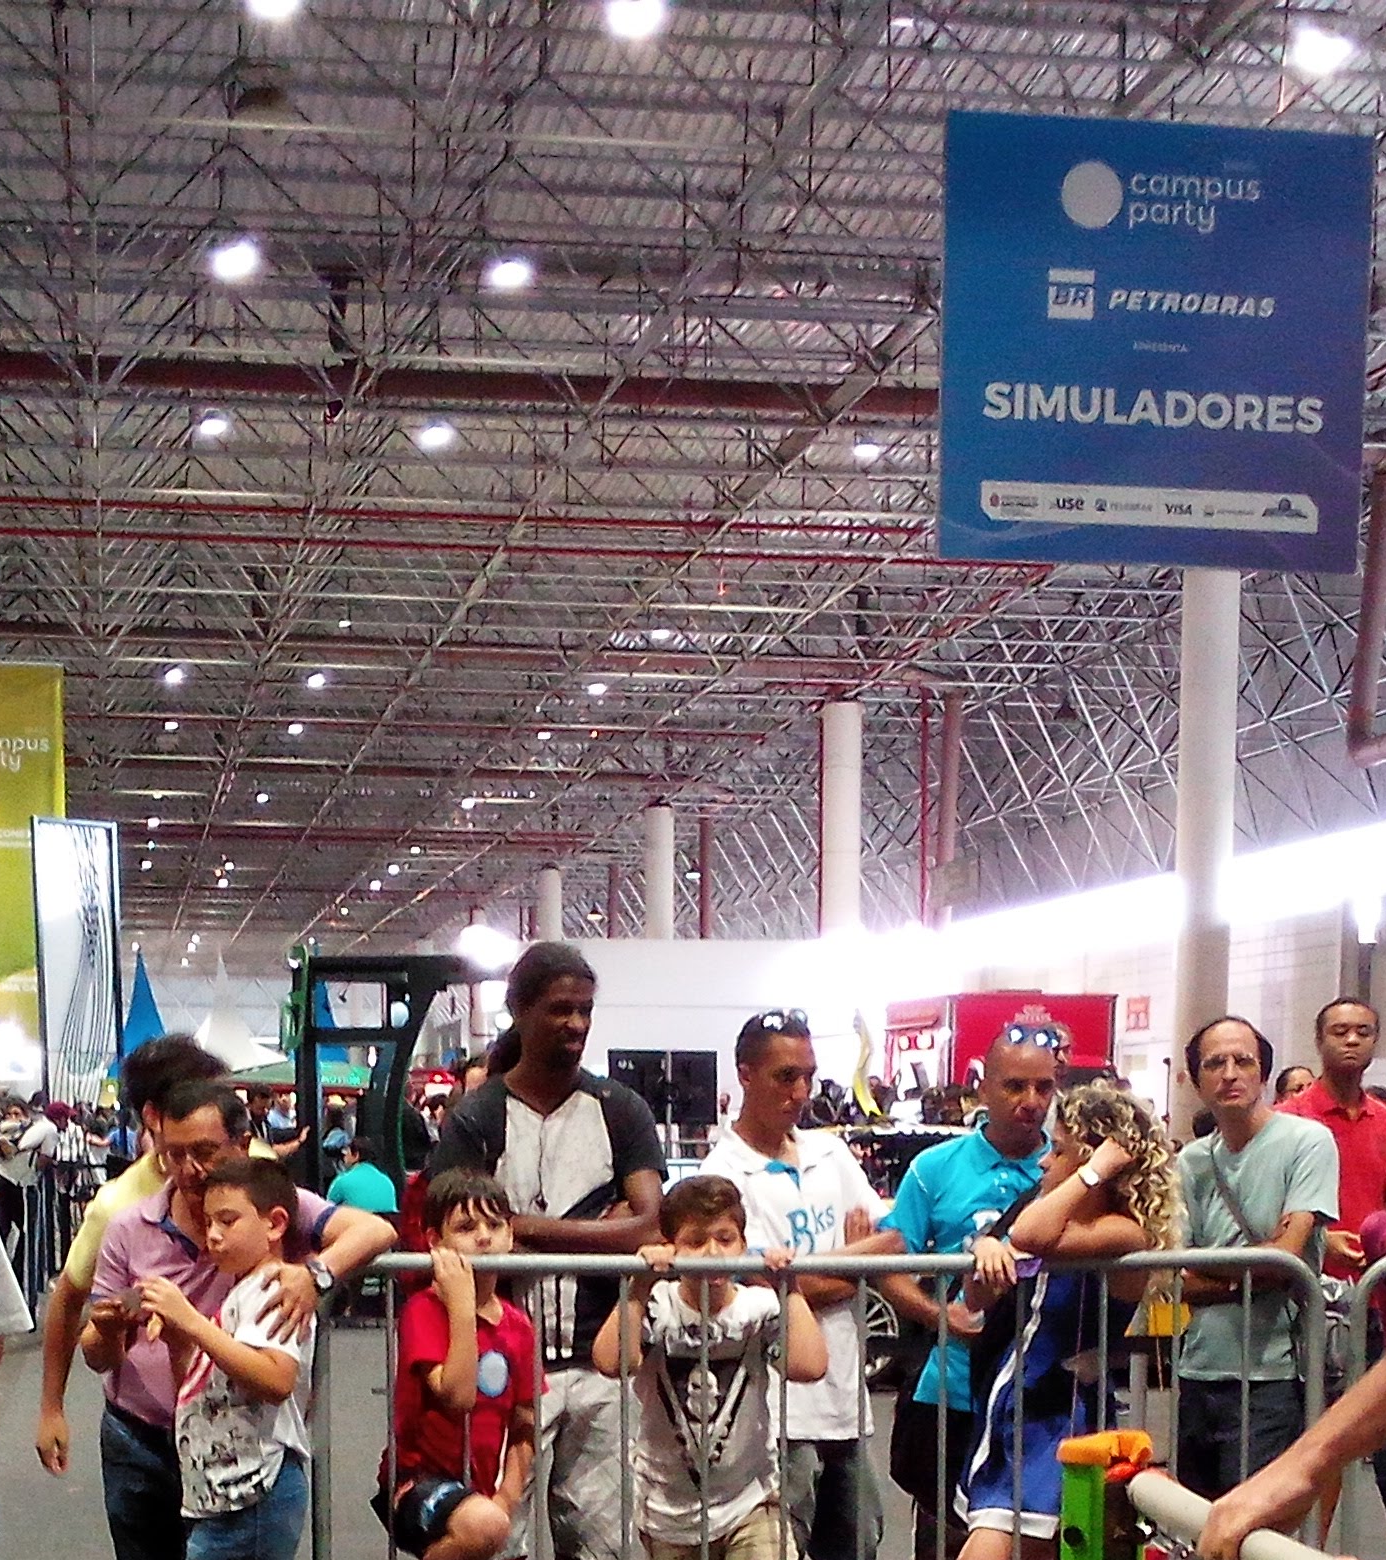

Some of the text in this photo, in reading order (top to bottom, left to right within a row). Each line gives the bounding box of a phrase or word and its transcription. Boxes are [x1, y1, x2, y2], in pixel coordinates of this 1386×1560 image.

[1129, 172, 1261, 201] campus
[1129, 202, 1216, 233] party
[1108, 289, 1276, 318] PETROBRAS
[983, 381, 1325, 433] SIMULADORES
[1164, 503, 1193, 516] VISA
